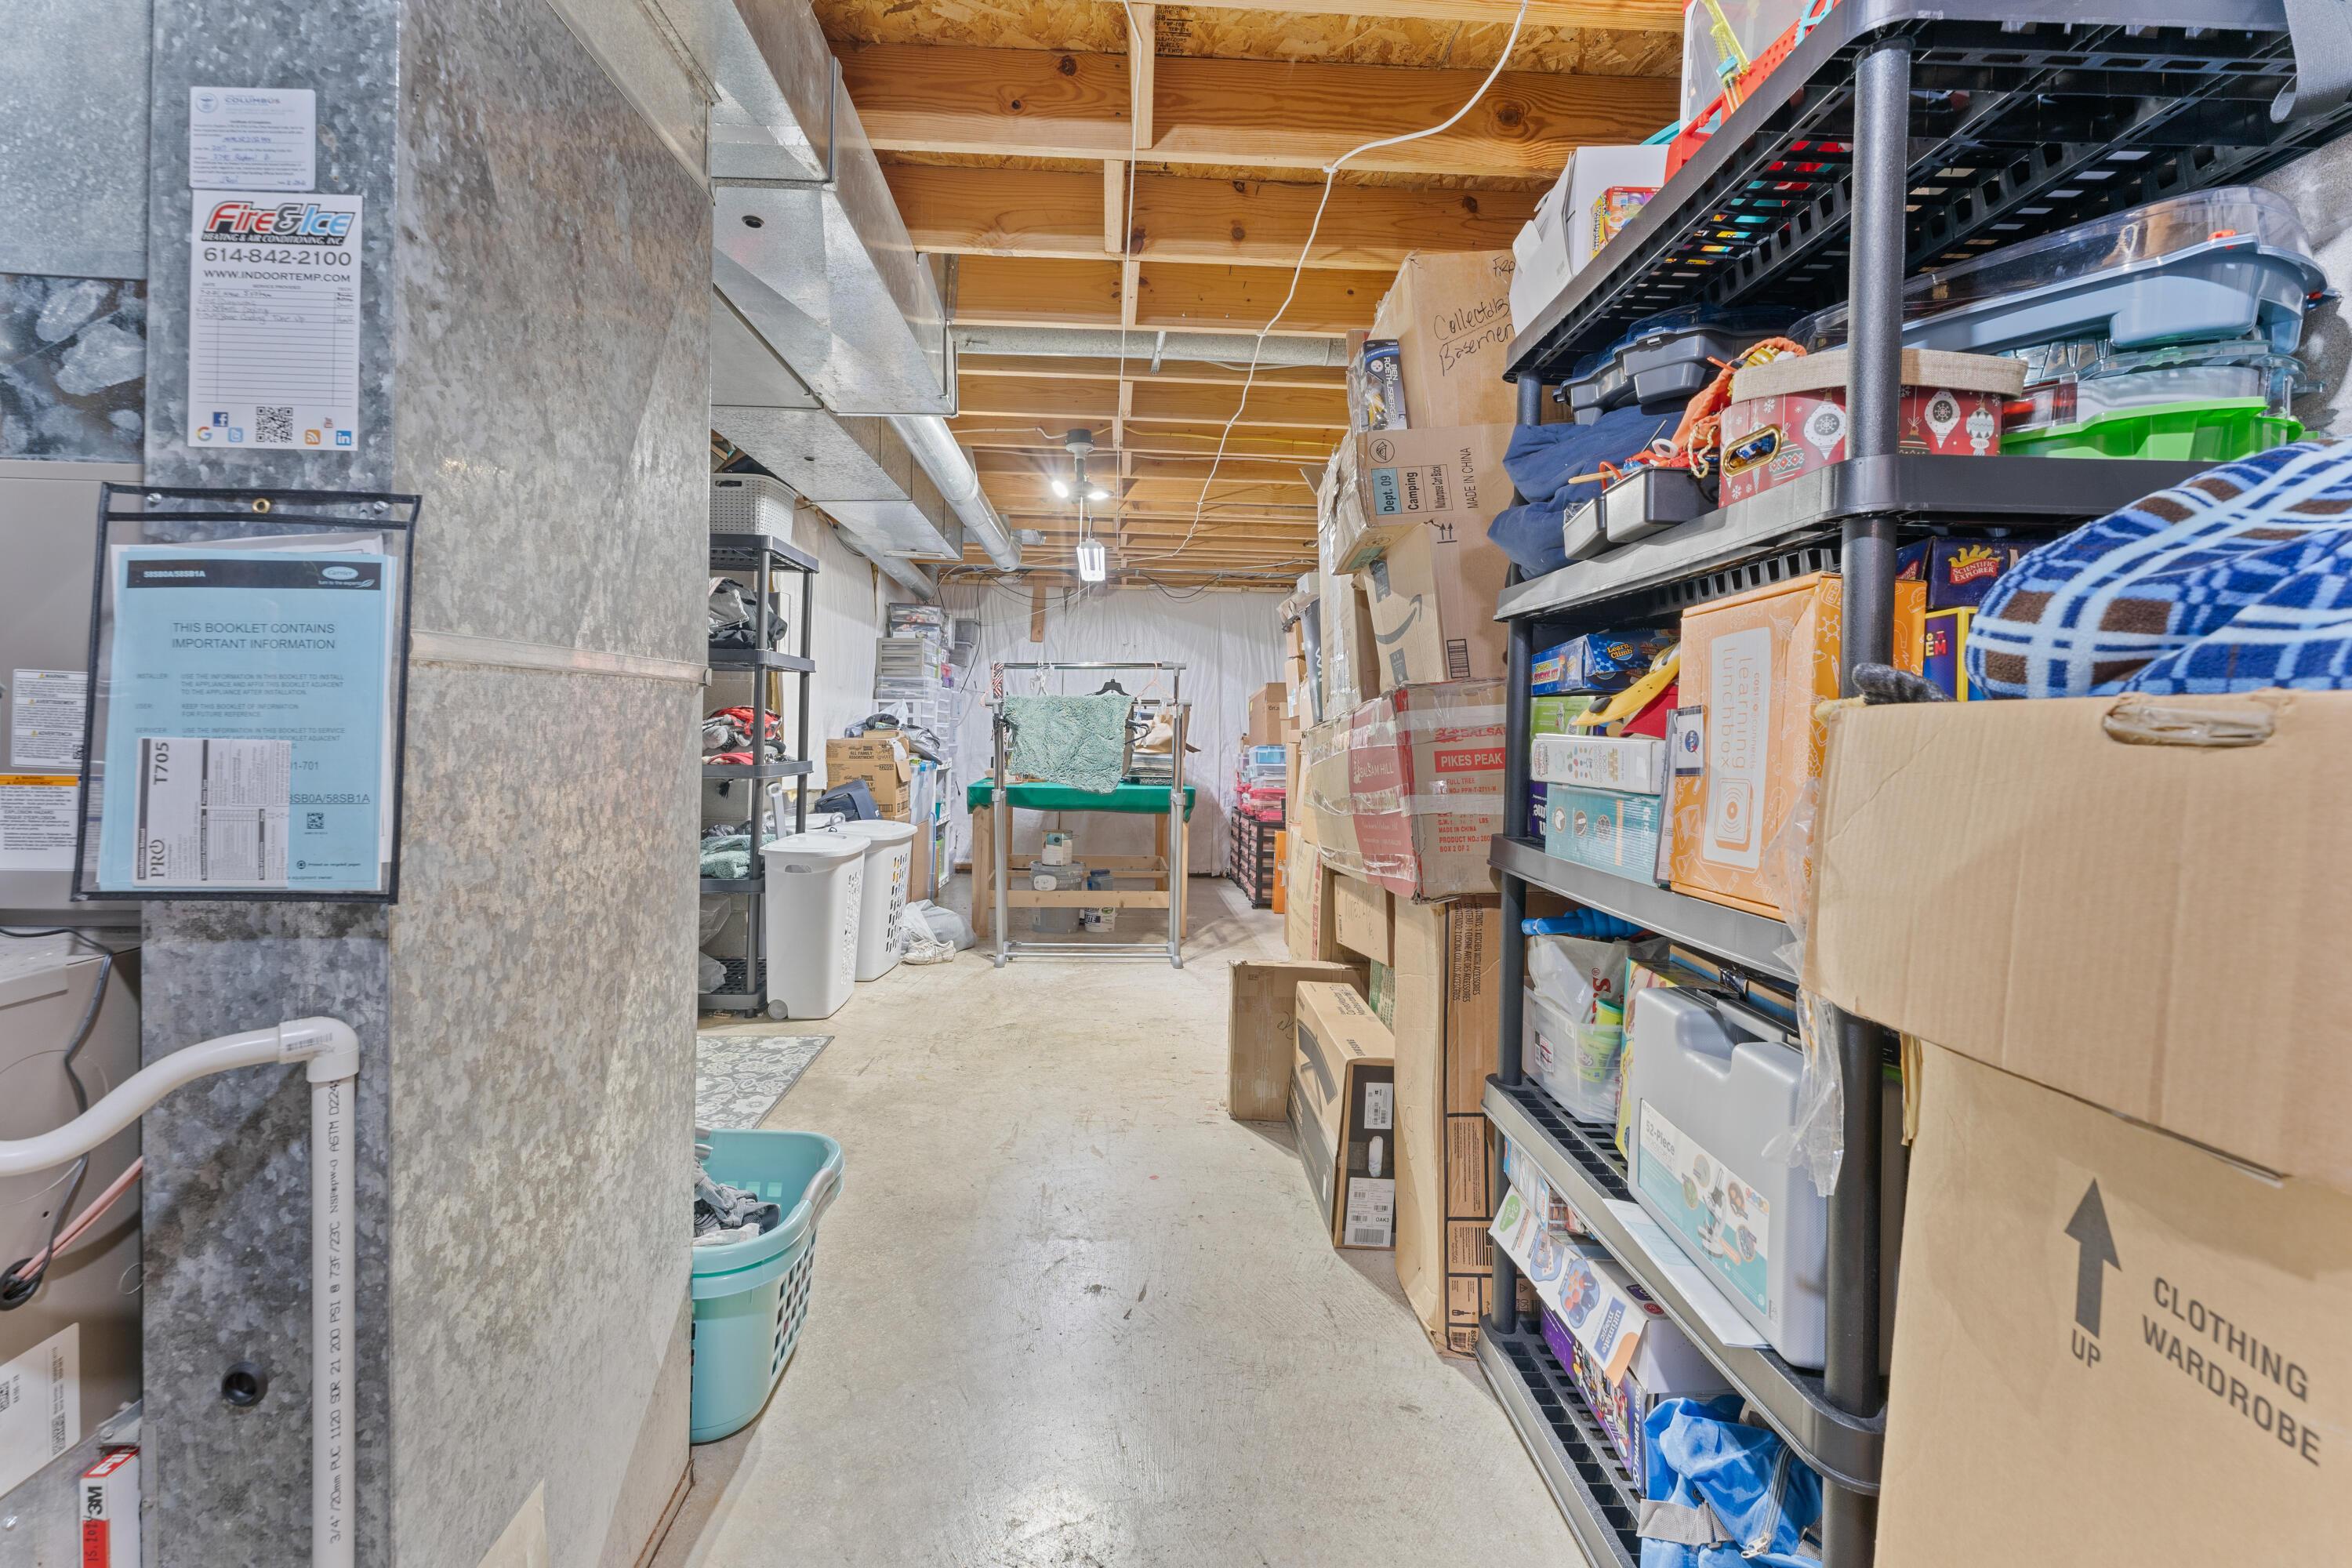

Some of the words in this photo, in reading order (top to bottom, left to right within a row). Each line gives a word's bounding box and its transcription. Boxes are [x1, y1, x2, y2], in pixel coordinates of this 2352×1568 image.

[202, 233, 238, 241] HEATING
[204, 248, 351, 266] 614-842-2100
[204, 270, 350, 282] WWW.INDOORTEMP.COM
[1460, 447, 1474, 470] CHINA
[1381, 475, 1392, 486] 09
[1464, 472, 1474, 482] IN
[1383, 488, 1396, 512] Dept.
[1405, 472, 1420, 510] Camping
[1434, 485, 1448, 509] Multipurpose
[1465, 484, 1479, 510] MADE
[327, 568, 354, 577] Carrier
[1953, 561, 1995, 575] SCIENTIFIC
[1955, 567, 1994, 582] EXPLORER
[173, 622, 201, 633] THIS
[205, 623, 267, 633] BOOKLET
[270, 624, 336, 634] CONTAINS
[172, 639, 248, 649] IMPORTANT
[250, 639, 336, 650] INFORMATION
[1607, 644, 1630, 652] Learn
[1610, 649, 1632, 659] Climb
[1720, 648, 1737, 768] lunchbox
[1731, 658, 1754, 769] learning
[154, 742, 169, 785] T705
[1359, 764, 1380, 778] BALSAM
[1380, 762, 1394, 776] HILL
[1441, 754, 1472, 767] PIKES
[1475, 753, 1503, 765] PEAK
[1474, 903, 1483, 927] CONTENTS:
[1474, 932, 1483, 952] KITCHEN
[1473, 953, 1482, 966] WITH
[329, 1120, 339, 1152] ASTM
[1646, 1120, 1675, 1156] 52-Piece
[330, 1300, 340, 1323] PSI
[330, 1328, 341, 1354] 200
[1600, 1309, 1622, 1353] ultimate
[2154, 1276, 2310, 1403] CLOTHING
[2071, 1329, 2102, 1368] UP
[330, 1358, 341, 1375] 21
[330, 1380, 341, 1404] SDR
[2142, 1315, 2321, 1468] WARDROBE
[330, 1410, 341, 1439] 1120
[87, 1486, 103, 1515] 3M
